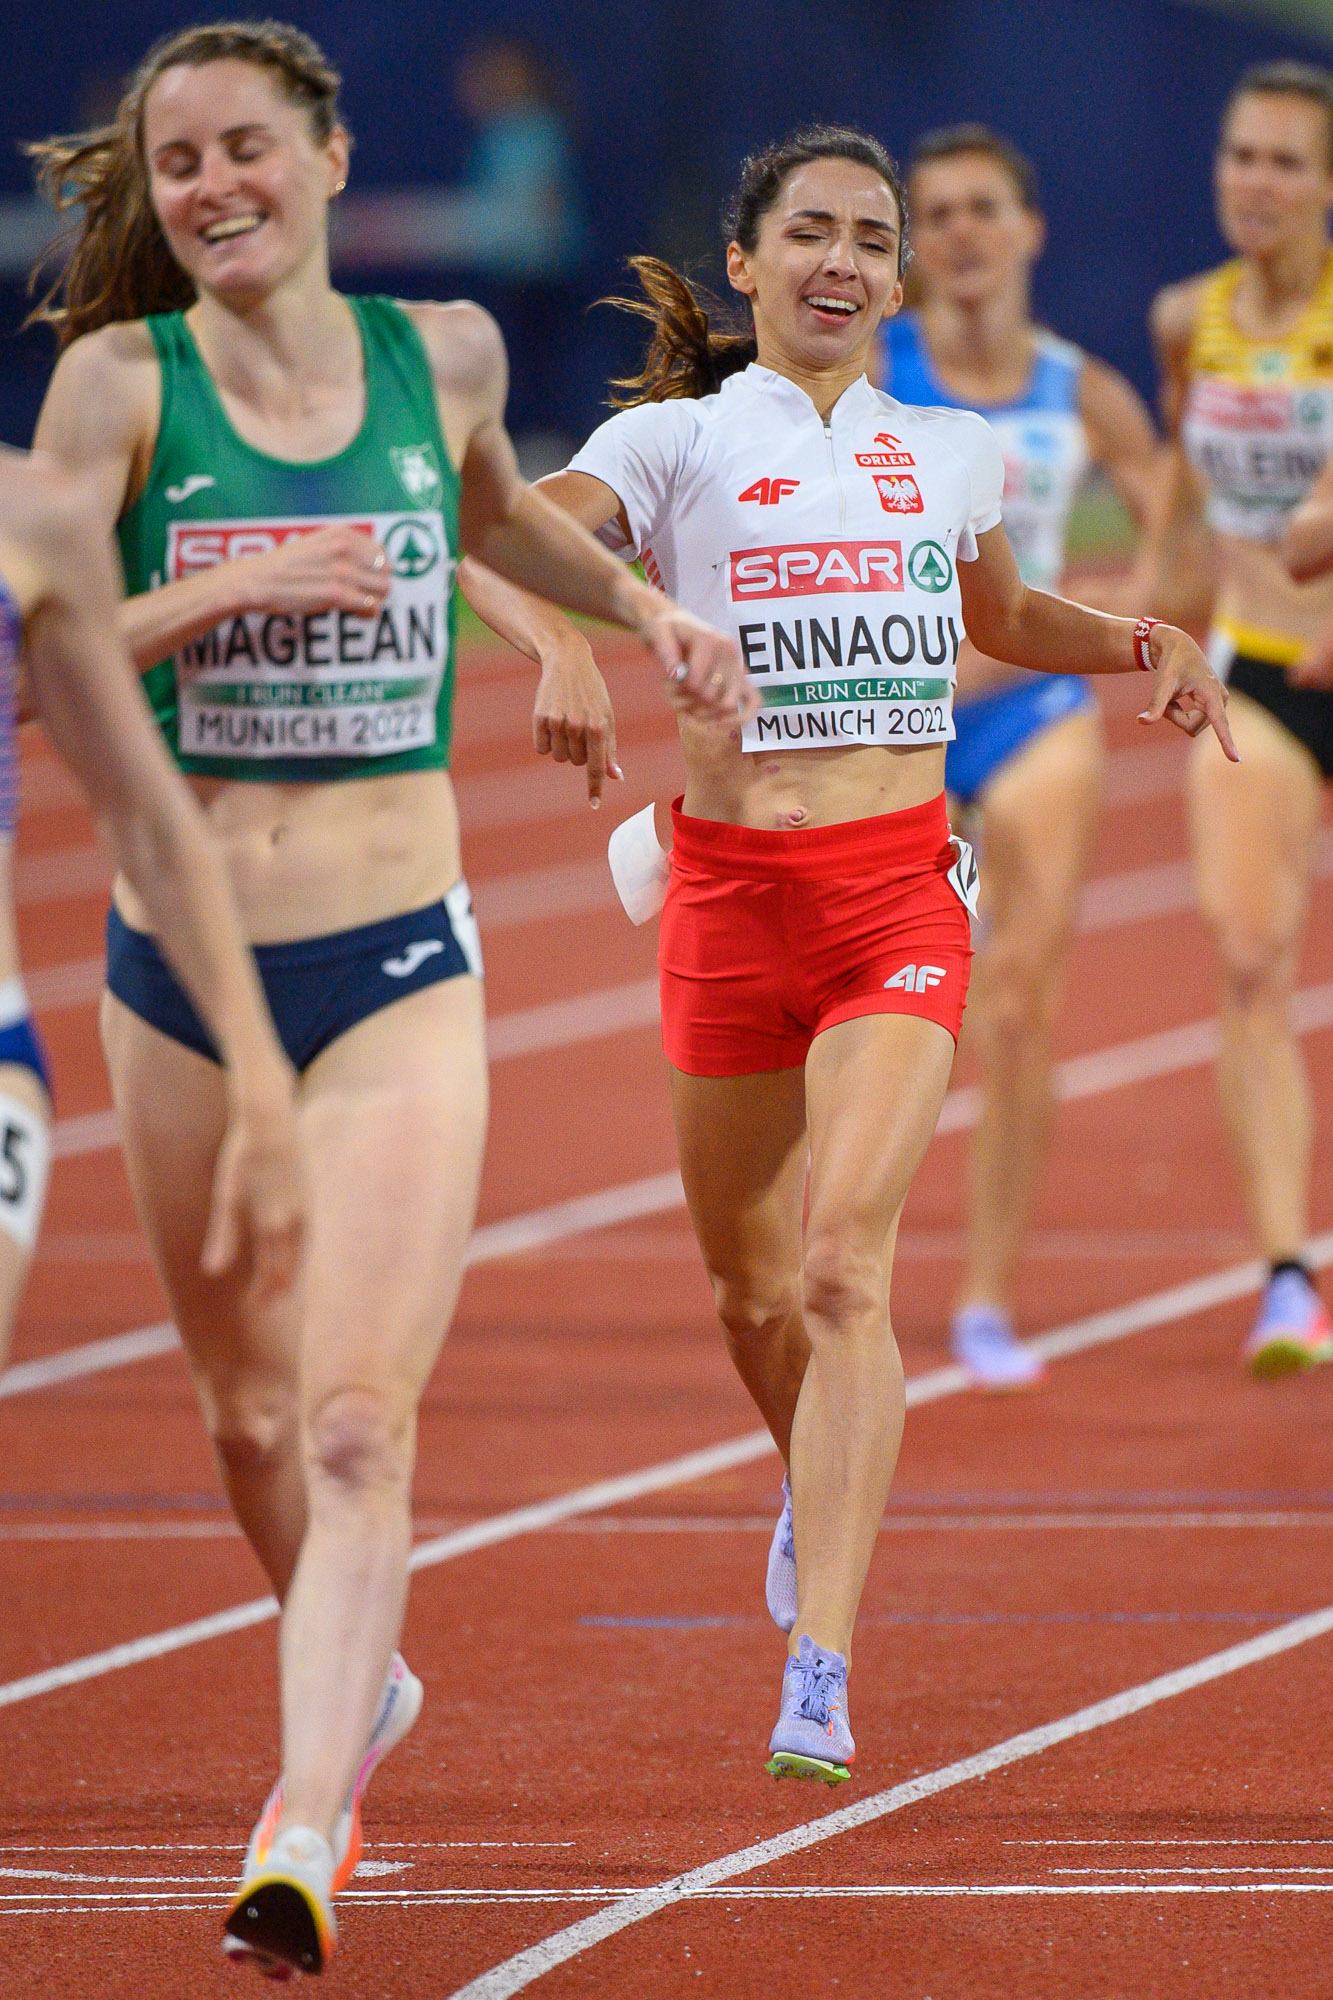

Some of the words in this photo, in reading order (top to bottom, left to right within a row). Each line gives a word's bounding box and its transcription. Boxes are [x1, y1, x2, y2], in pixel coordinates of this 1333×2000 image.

[858, 454, 912, 467] ORLEN
[737, 477, 801, 506] 4F
[735, 547, 899, 593] SPAR
[738, 614, 959, 675] ENNAOUI
[793, 686, 799, 702] I
[805, 683, 850, 702] RUN
[197, 711, 338, 746] MUNICH
[351, 704, 422, 744] 2022
[756, 708, 876, 741] MUNICH
[888, 705, 947, 735] 2022
[883, 963, 947, 993] 4F
